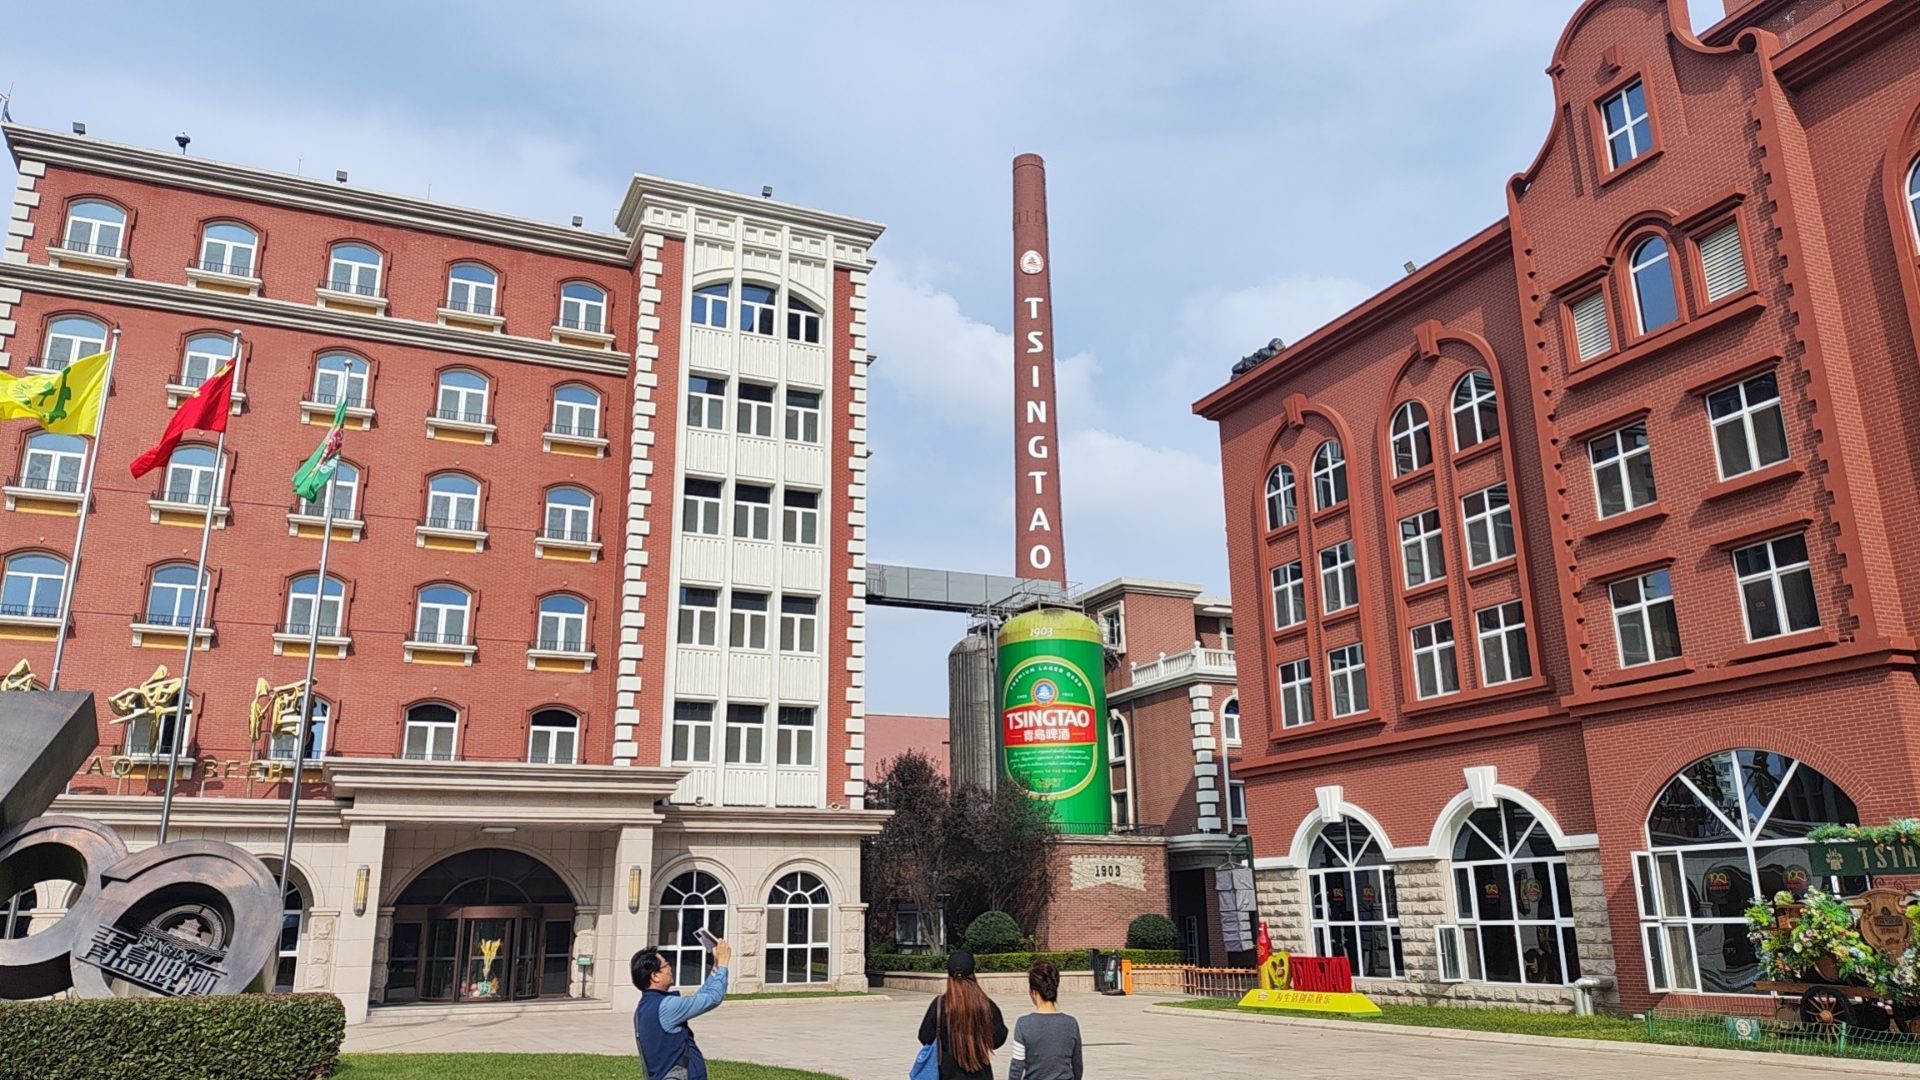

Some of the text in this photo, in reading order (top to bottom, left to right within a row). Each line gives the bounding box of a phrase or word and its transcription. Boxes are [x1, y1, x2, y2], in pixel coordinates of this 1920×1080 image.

[1024, 297, 1052, 569] TSINGTAO
[1030, 627, 1053, 637] 1903
[1066, 671, 1082, 687] BEER
[1006, 709, 1090, 731] TSINGTAO
[203, 758, 284, 779] BEER
[1095, 865, 1121, 877] 1903
[136, 931, 199, 964] TSINGTAO
